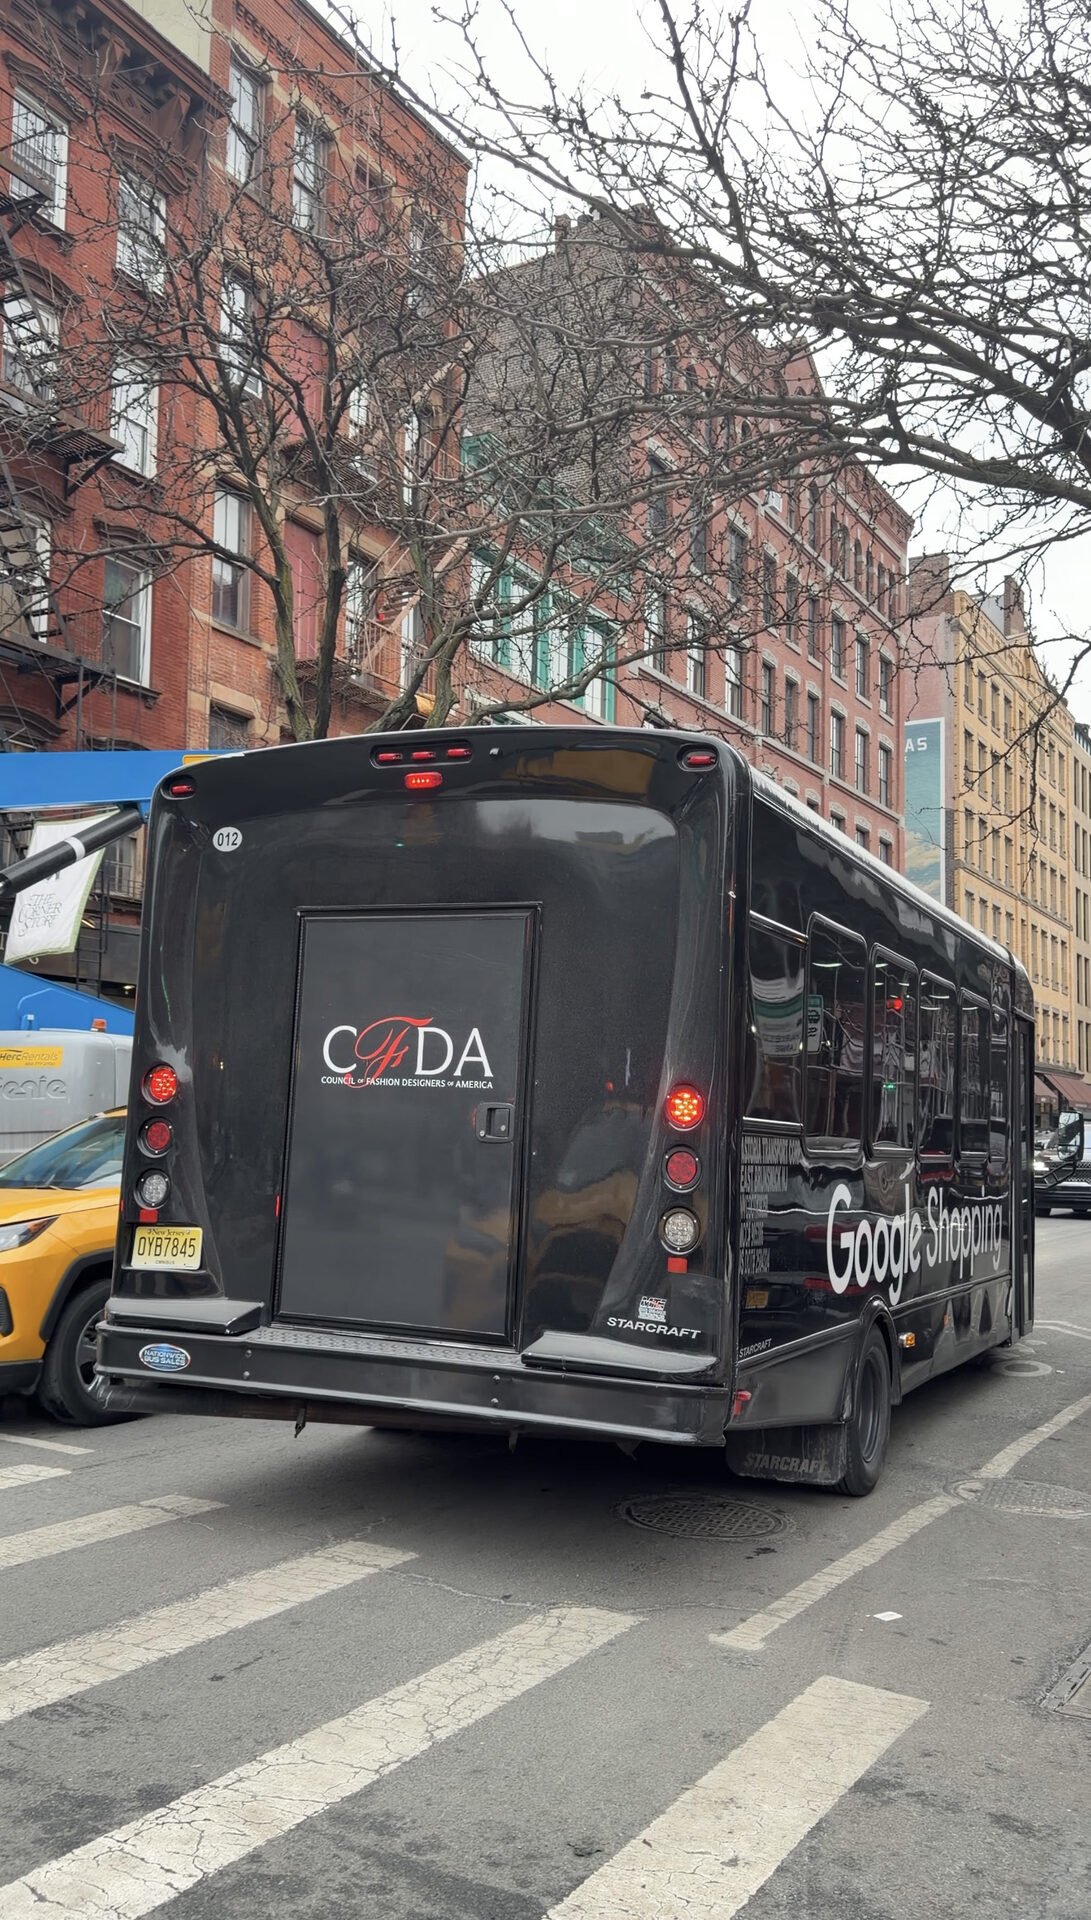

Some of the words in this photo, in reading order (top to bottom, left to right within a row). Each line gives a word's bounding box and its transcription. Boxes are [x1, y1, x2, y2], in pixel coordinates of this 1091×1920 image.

[217, 832, 239, 847] 012
[30, 893, 56, 906] THE
[322, 1016, 494, 1089] CFDA
[321, 1075, 356, 1085] COUNCIL
[366, 1077, 400, 1086] FASHION
[401, 1078, 446, 1088] DESIGNERS
[455, 1080, 494, 1089] AMERICA
[152, 1228, 165, 1236] New
[166, 1228, 185, 1236] Jersey
[827, 1183, 923, 1305] Google
[926, 1185, 1002, 1279] Shopping
[607, 1316, 701, 1339] STARCRAFT
[739, 1338, 772, 1358] STARCRAFT
[160, 1357, 186, 1366] SALES
